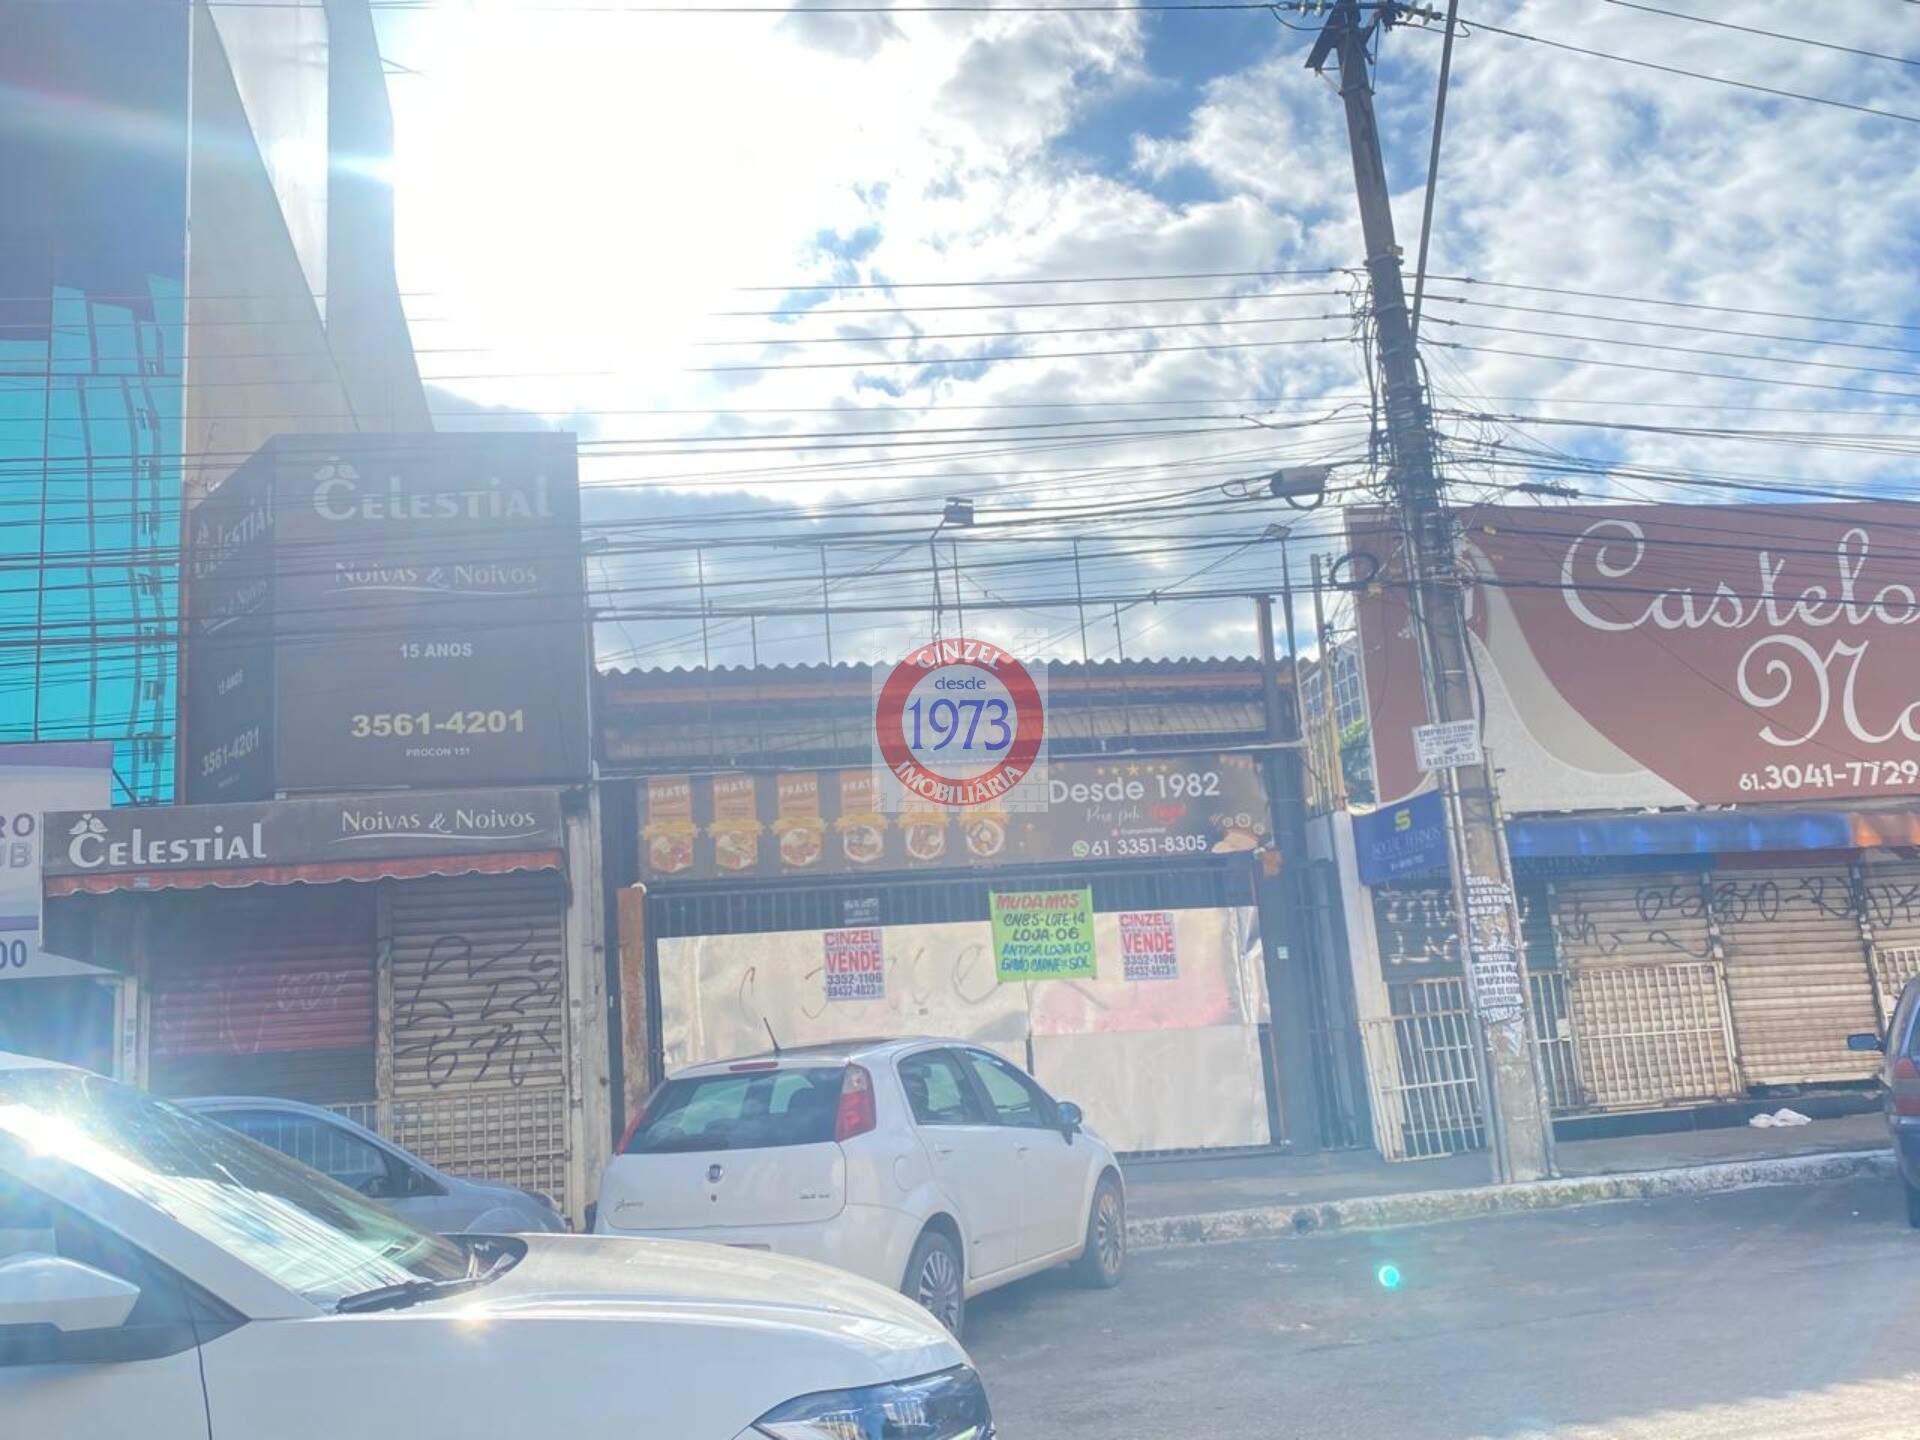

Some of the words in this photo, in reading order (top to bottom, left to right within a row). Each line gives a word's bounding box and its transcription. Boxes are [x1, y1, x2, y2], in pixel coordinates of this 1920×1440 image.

[1560, 519, 1920, 630] Castelo
[400, 643, 421, 660] 15
[425, 641, 473, 659] ANOS
[352, 708, 526, 738] 3561-4201
[1050, 778, 1142, 804] Desde
[1156, 773, 1219, 799] 1982
[1739, 765, 1918, 791] 61.3041-7729
[428, 811, 453, 833] &
[1091, 841, 1110, 856] 61
[1117, 835, 1208, 855] 3351-8305
[996, 893, 1079, 912] MUDAMOS
[824, 930, 880, 946] CINZEL
[1121, 932, 1175, 953] VENDE
[825, 951, 881, 974] VENDE
